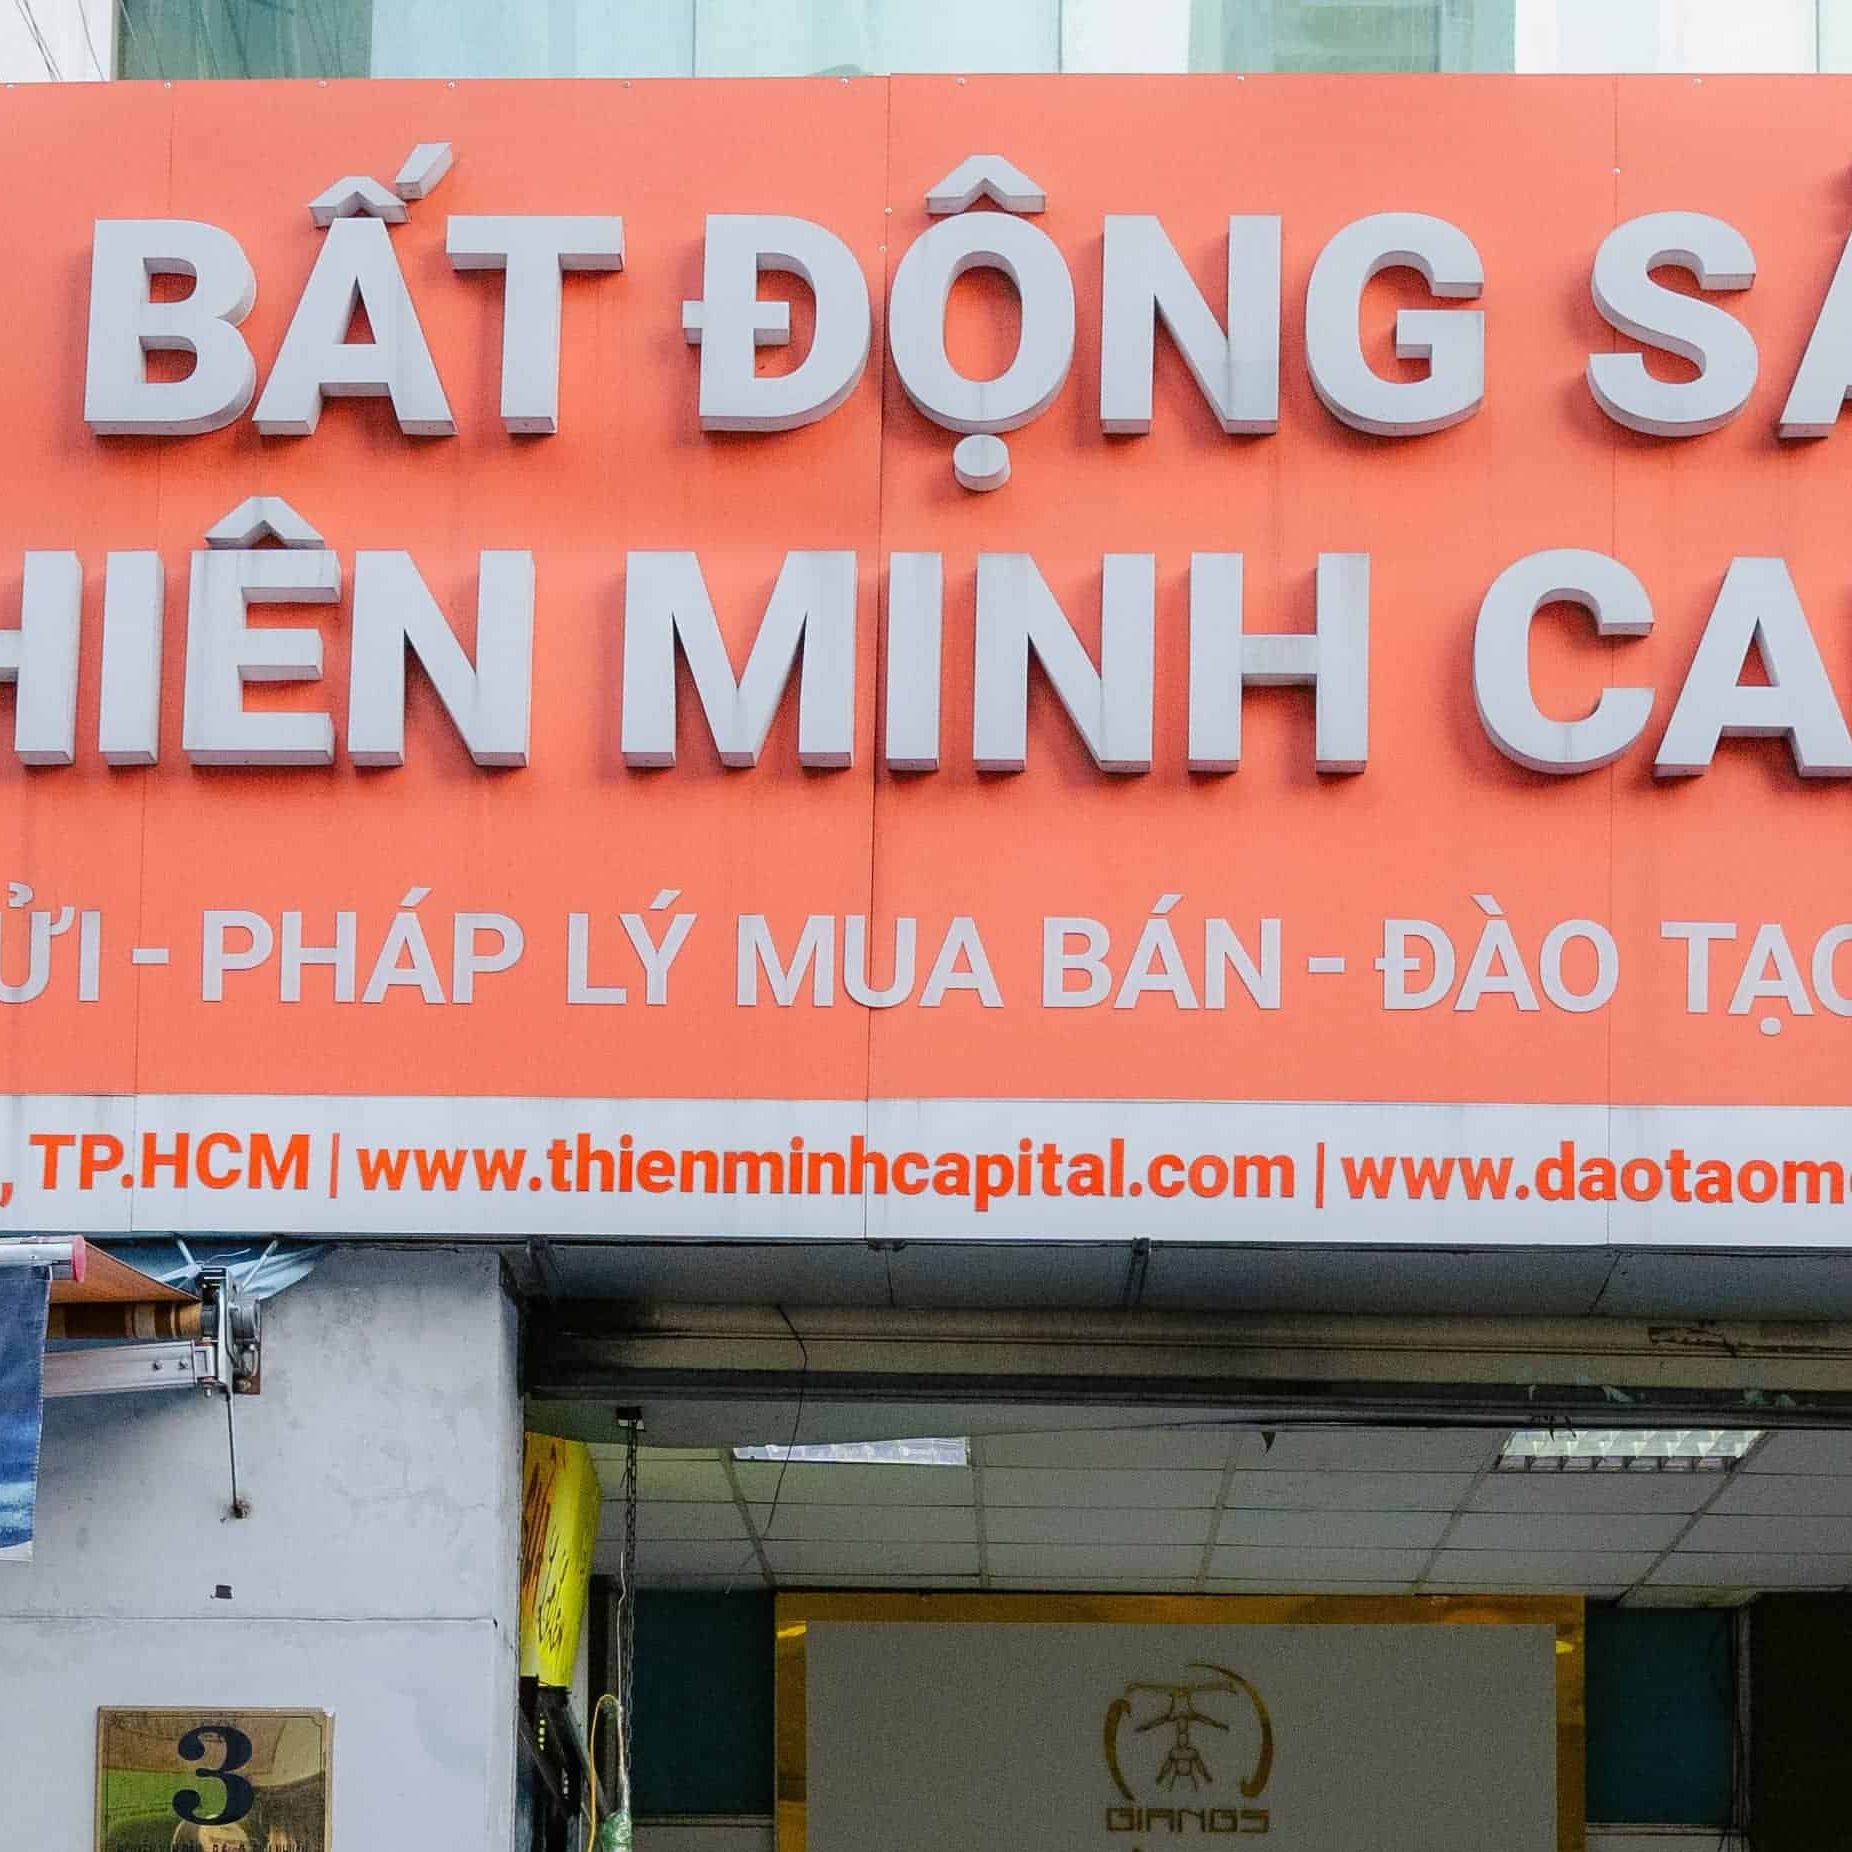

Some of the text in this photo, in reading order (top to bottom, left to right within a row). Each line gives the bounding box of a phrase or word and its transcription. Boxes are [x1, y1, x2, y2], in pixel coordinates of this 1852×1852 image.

[84, 141, 623, 437] BẤT
[682, 152, 1486, 491] ĐỘNG
[620, 550, 1370, 774] MINH
[202, 887, 525, 1006] PHÁP
[567, 889, 695, 1007] LÝ
[736, 914, 1004, 1010] MUA
[1043, 894, 1281, 1011] BÁN
[1375, 895, 1619, 1014] ĐÀO
[30, 1132, 309, 1191] TP.HCM
[358, 1132, 1294, 1212] www.thienminhcapital.com
[171, 1725, 256, 1826] 3
